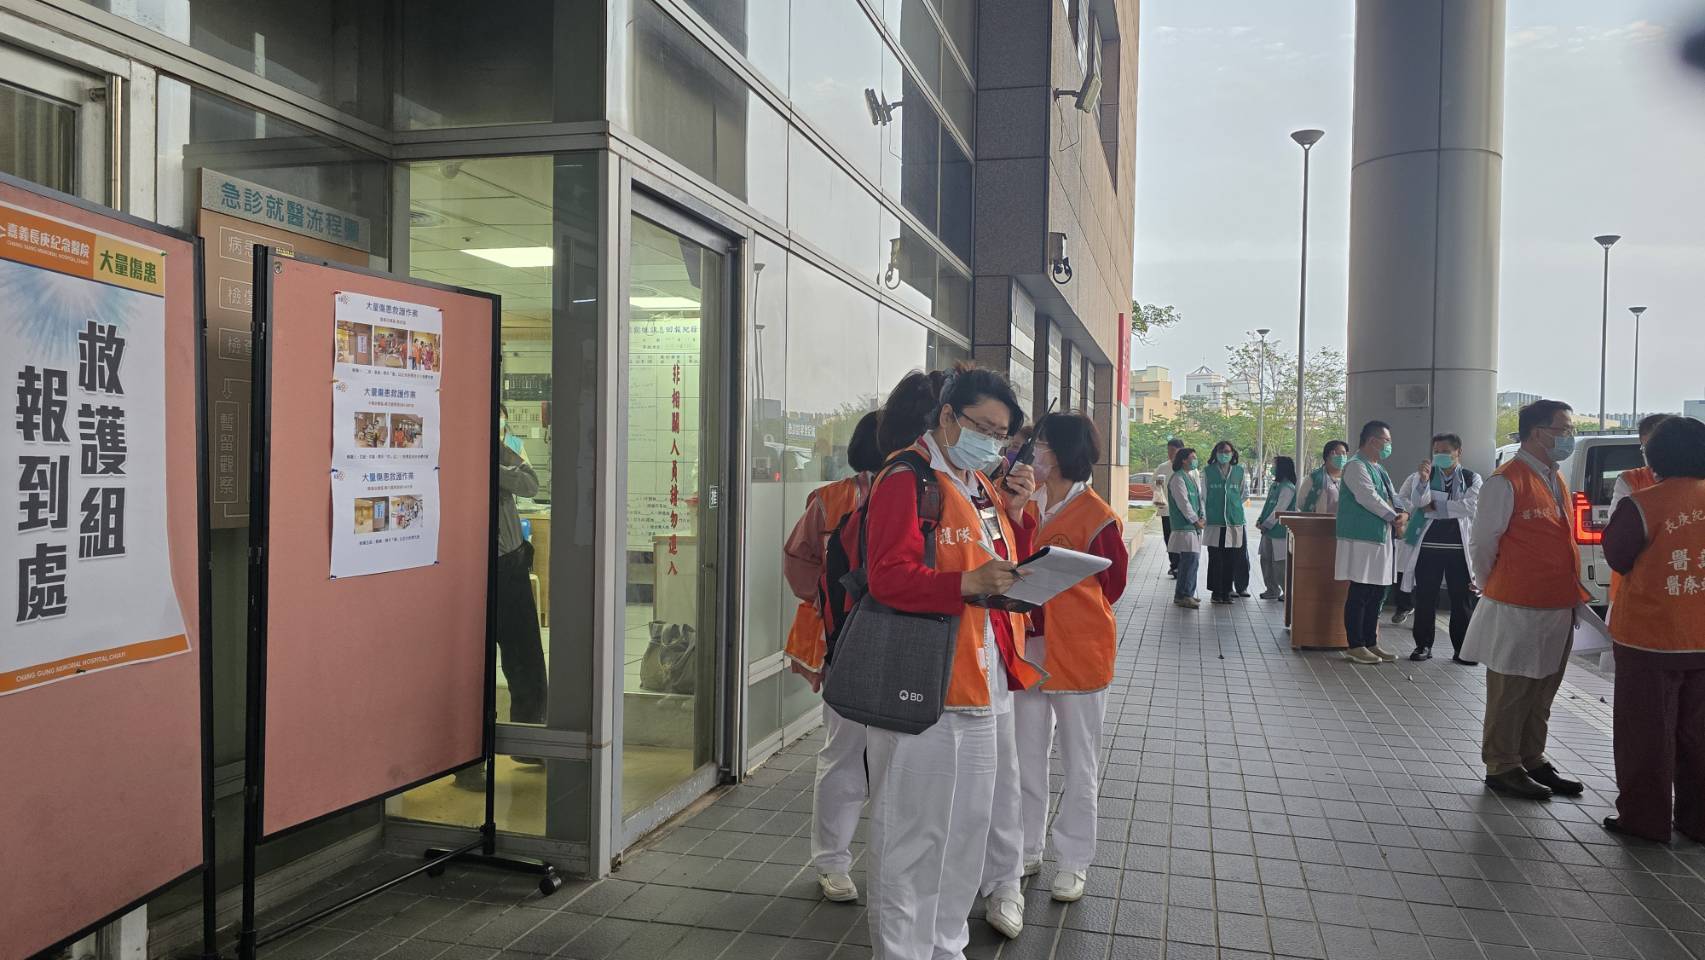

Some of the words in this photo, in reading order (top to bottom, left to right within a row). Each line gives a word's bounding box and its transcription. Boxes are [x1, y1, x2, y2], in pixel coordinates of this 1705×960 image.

[7, 222, 90, 258] 嘉義長庚紀念醫院
[100, 250, 157, 285] 大量傷患
[78, 320, 128, 559] 救護組
[15, 365, 71, 624] 報到處
[1664, 574, 1705, 596] 醫療
[910, 692, 924, 702] BD
